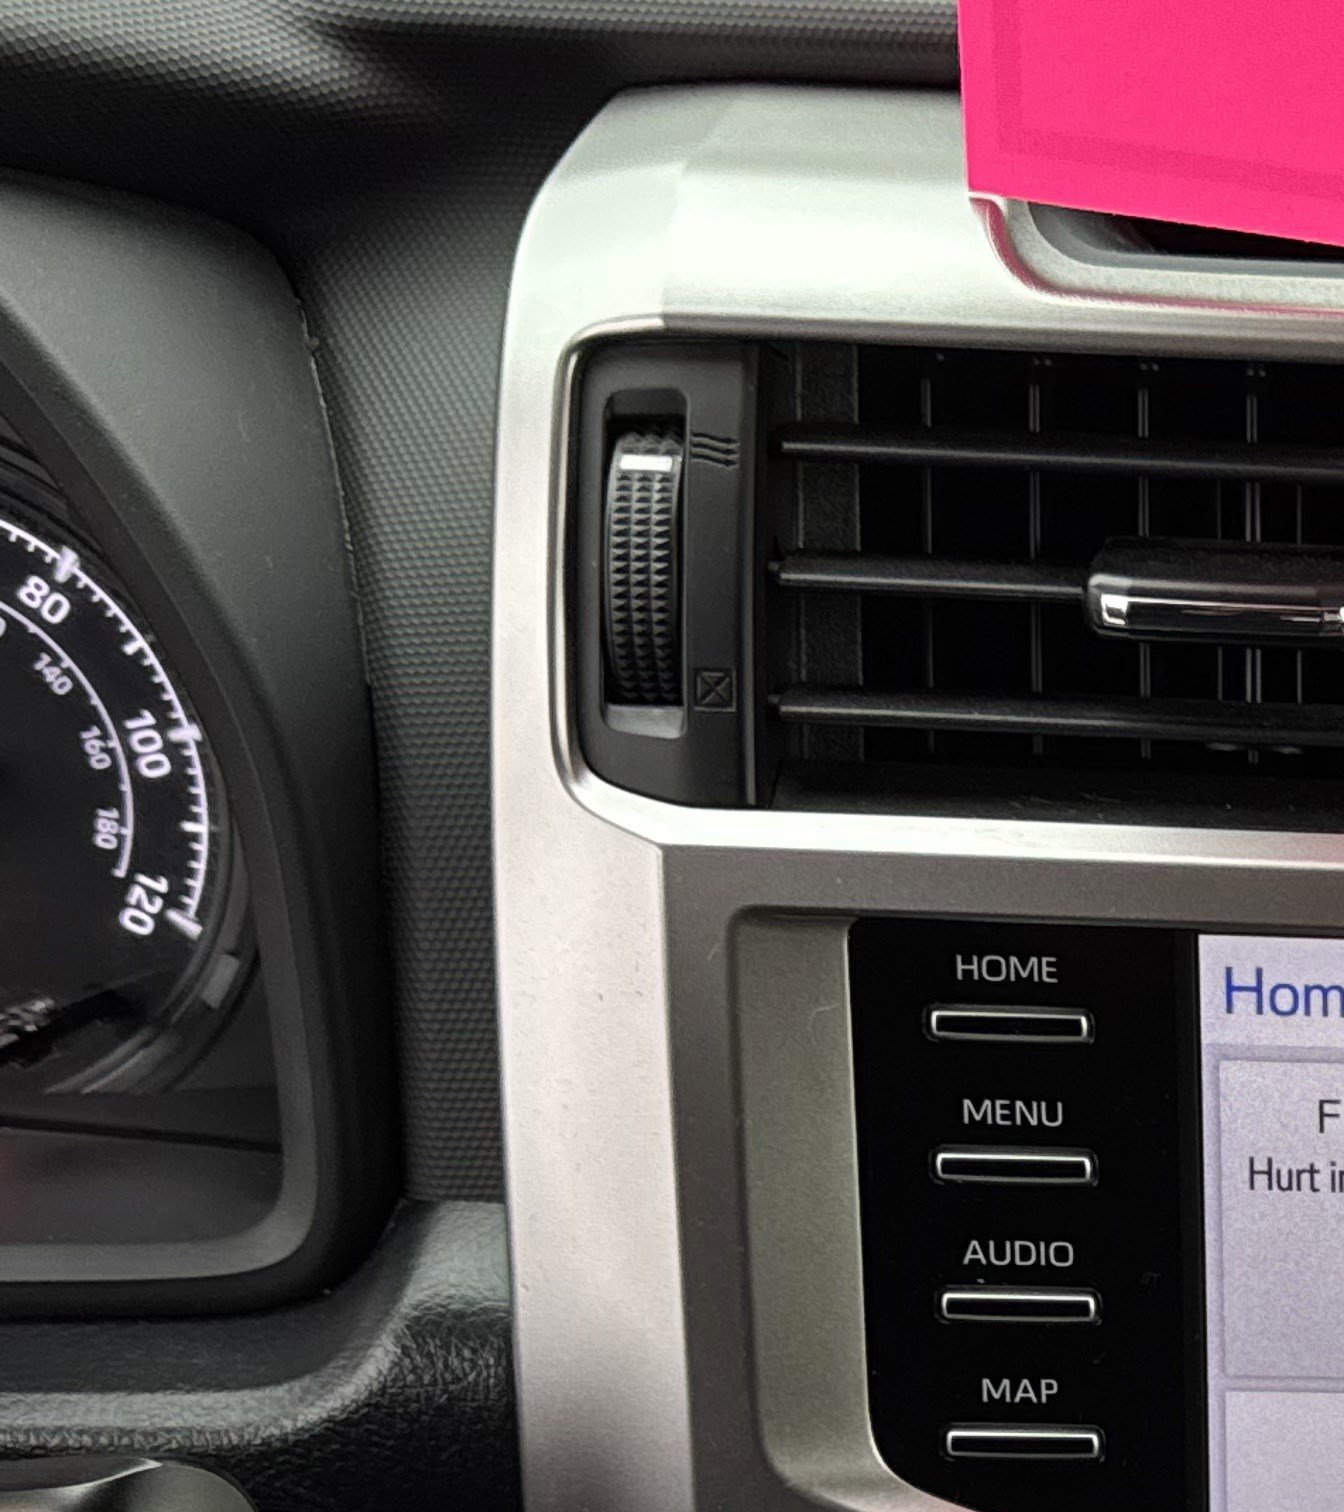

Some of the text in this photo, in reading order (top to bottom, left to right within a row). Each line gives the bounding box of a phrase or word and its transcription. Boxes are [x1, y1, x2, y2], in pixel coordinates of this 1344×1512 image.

[16, 575, 71, 625] 80
[33, 651, 73, 696] 140
[79, 725, 111, 770] 160
[122, 708, 172, 780] 100
[92, 806, 119, 850] 180
[118, 872, 169, 937] 120
[955, 953, 1058, 984] HOME
[962, 1098, 1064, 1127] MENU
[1247, 1156, 1320, 1193] Hurt
[963, 1240, 1075, 1268] AUDIO
[981, 1378, 1059, 1405] MAP
